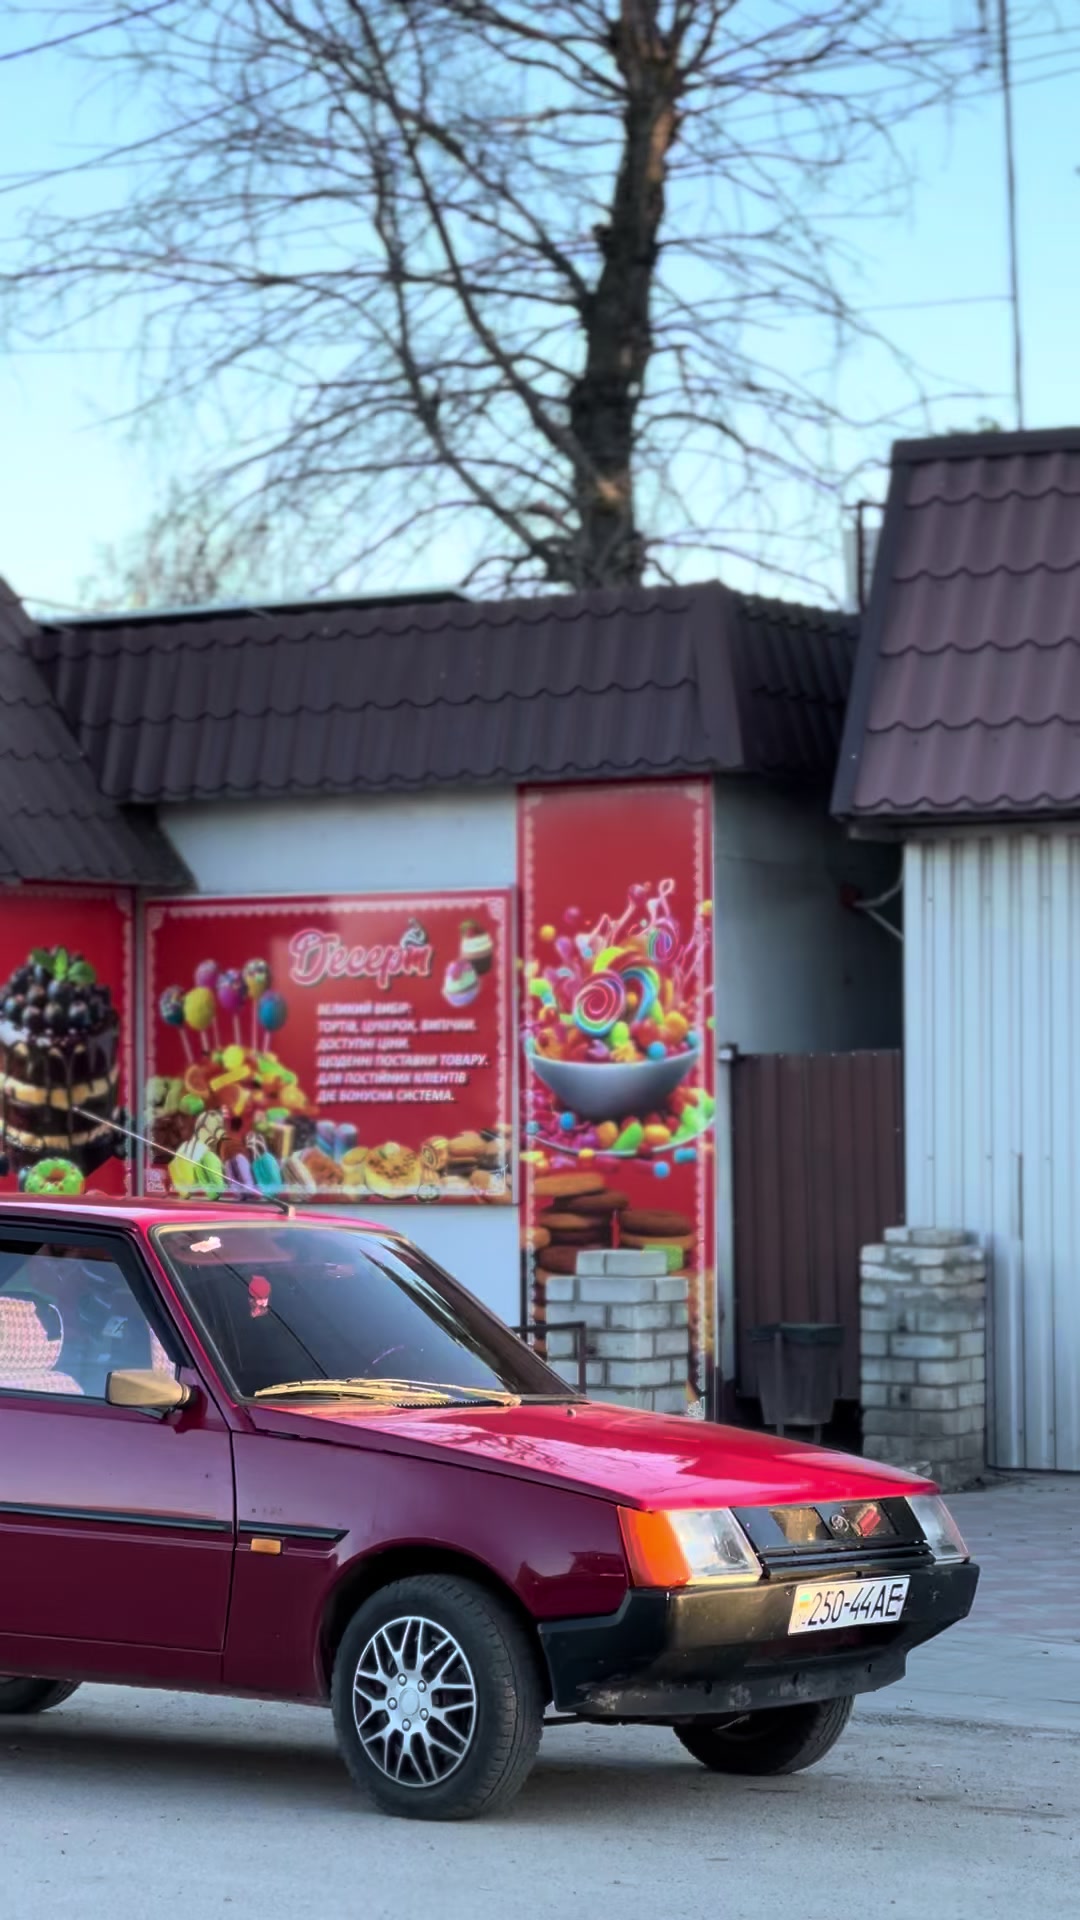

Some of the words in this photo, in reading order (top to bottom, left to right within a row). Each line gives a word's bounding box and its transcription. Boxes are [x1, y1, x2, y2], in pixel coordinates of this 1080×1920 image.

[289, 928, 432, 990] Десерт
[375, 1054, 438, 1067] ПОСТАВКИ
[440, 1053, 488, 1067] ТОВАРУ.
[316, 1073, 342, 1086] ДЛЯ
[339, 1090, 393, 1102] БОНУСНА
[396, 1089, 455, 1101] СИСТЕМА.
